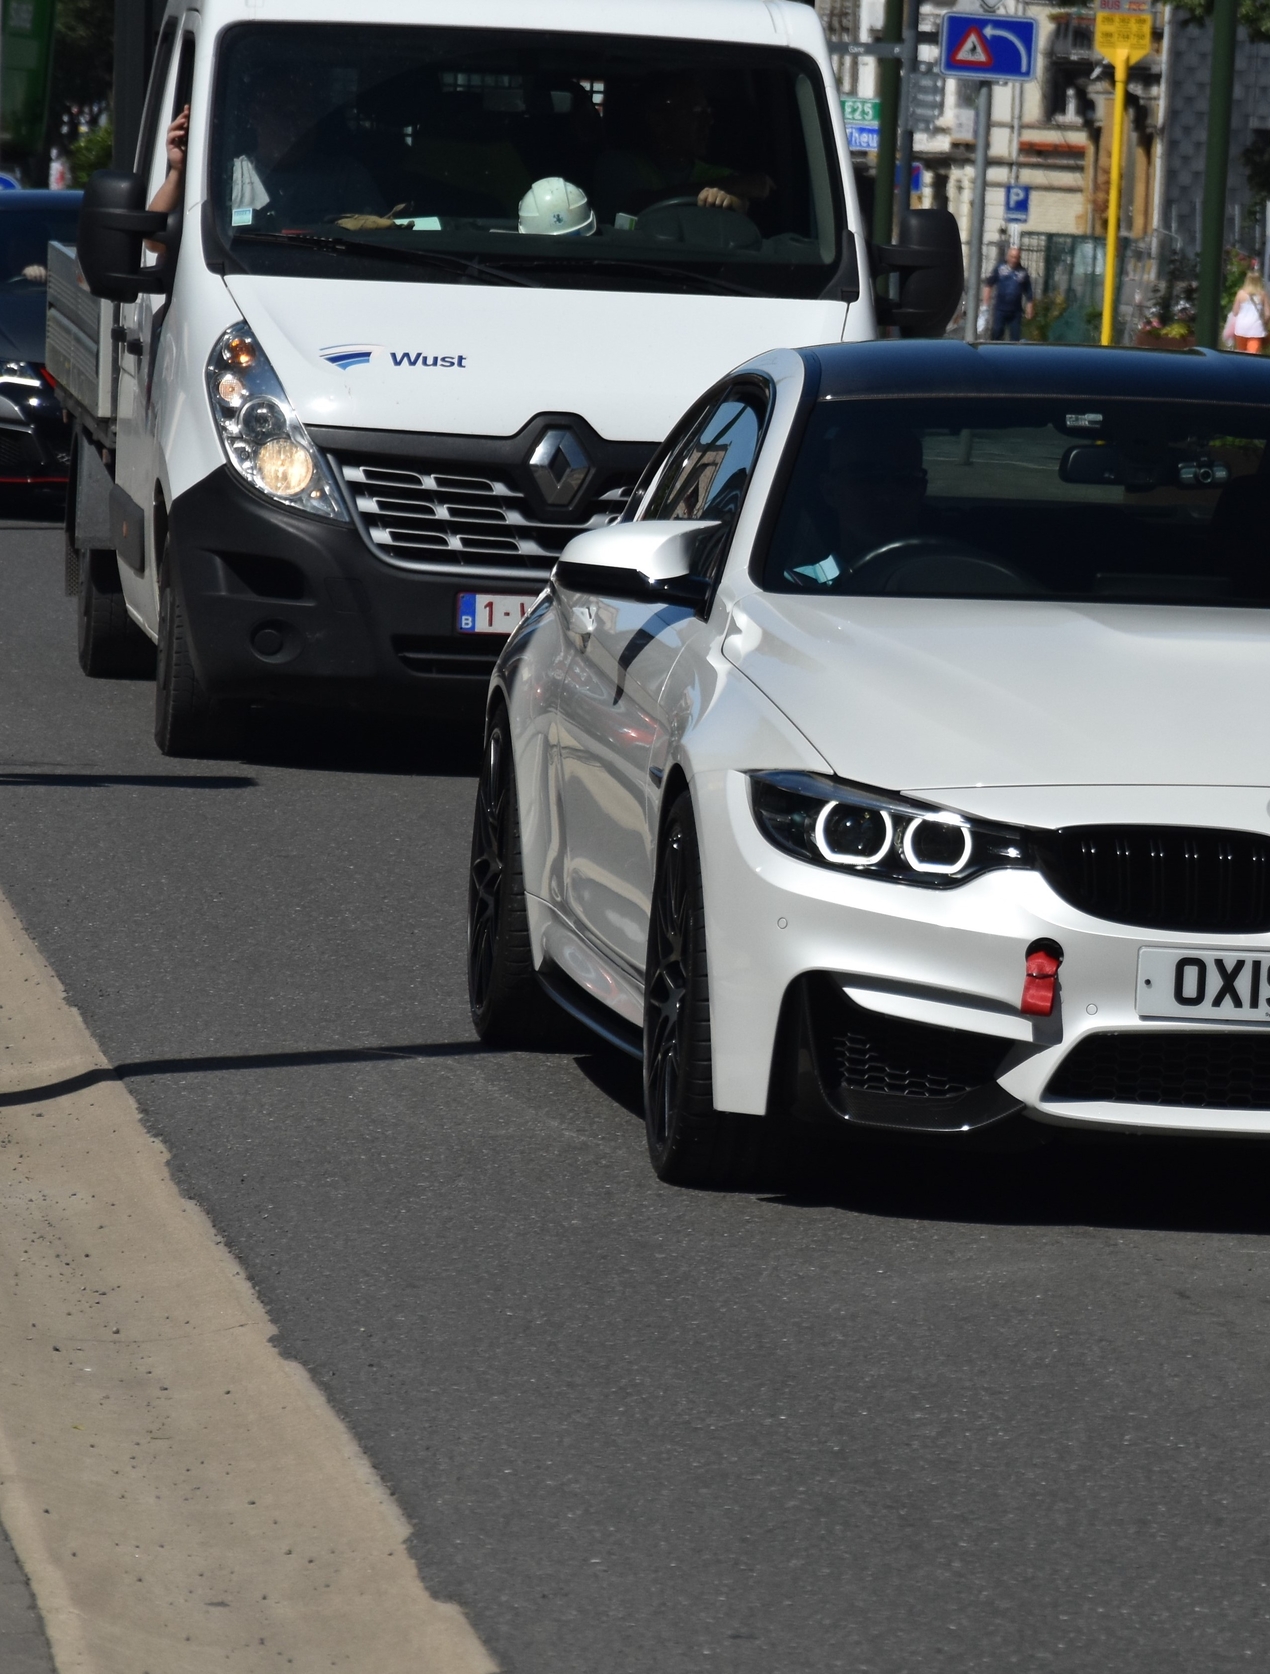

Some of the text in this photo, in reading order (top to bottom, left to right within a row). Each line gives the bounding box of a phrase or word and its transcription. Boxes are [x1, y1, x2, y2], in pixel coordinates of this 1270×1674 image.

[1100, 0, 1121, 10] BUS
[845, 102, 873, 120] E25
[1010, 188, 1024, 208] P
[390, 352, 467, 369] Wust
[461, 615, 472, 629] B
